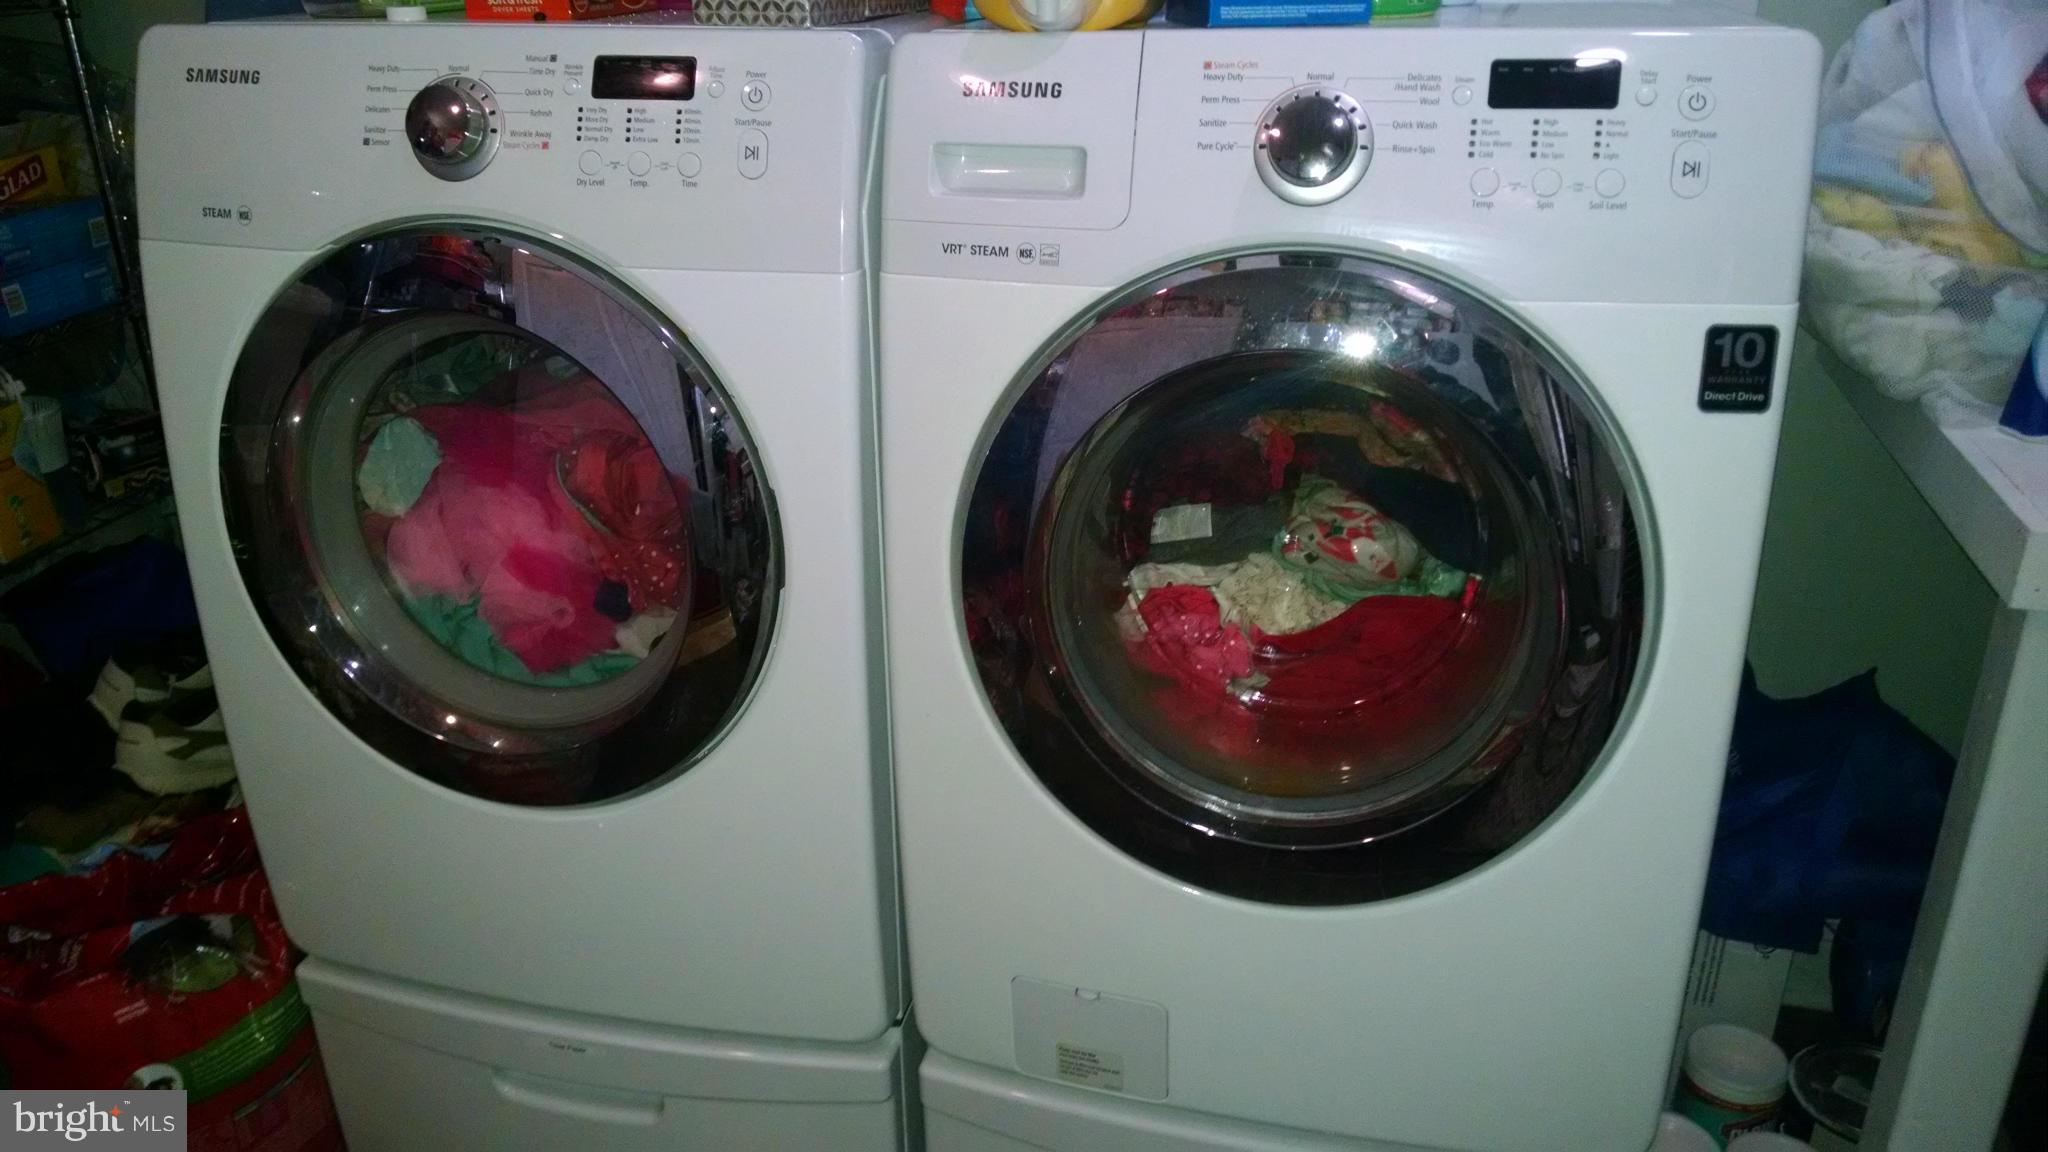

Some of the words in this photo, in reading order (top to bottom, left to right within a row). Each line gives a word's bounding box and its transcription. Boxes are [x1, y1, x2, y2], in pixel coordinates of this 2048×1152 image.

[368, 65, 384, 73] Heavy
[386, 65, 400, 73] Duty
[1214, 61, 1234, 69] Steam
[1236, 61, 1258, 70] Cycles
[186, 68, 260, 84] SAMSUNG
[544, 68, 556, 76] Dry
[746, 70, 767, 78] Power
[1307, 72, 1334, 80] Normal
[1203, 72, 1226, 82] Heavy
[1228, 72, 1244, 82] Duty
[1408, 73, 1442, 82] Delicates
[1687, 74, 1712, 83] Power
[963, 82, 1062, 98] SAMSUNG
[1394, 83, 1415, 92] /Hand
[1418, 83, 1441, 92] Wash
[524, 88, 540, 96] Quick
[541, 89, 554, 98] Dry
[1201, 96, 1220, 104] Perm
[1420, 97, 1440, 105] Wool
[598, 116, 608, 124] Dry
[734, 118, 772, 127] Start/Pause
[1199, 118, 1228, 126] Sanitize
[364, 126, 386, 134] Sanitize
[1392, 121, 1414, 130] Quick
[1416, 121, 1438, 130] Wash
[510, 130, 534, 138] Wrinkle
[1672, 129, 1718, 138] Start/Pause
[1197, 142, 1213, 150] Pure
[0, 162, 41, 200] GLAD
[577, 178, 589, 188] Dry
[590, 178, 605, 186] Level
[682, 180, 698, 188] Time
[1537, 200, 1554, 210] Spin
[1589, 200, 1604, 210] Soil
[1606, 200, 1627, 210] Level
[202, 208, 232, 219] STEAM
[970, 246, 1009, 258] STEAM
[1714, 332, 1766, 368] 10
[1704, 391, 1736, 400] Direct
[1738, 392, 1765, 400] Drive
